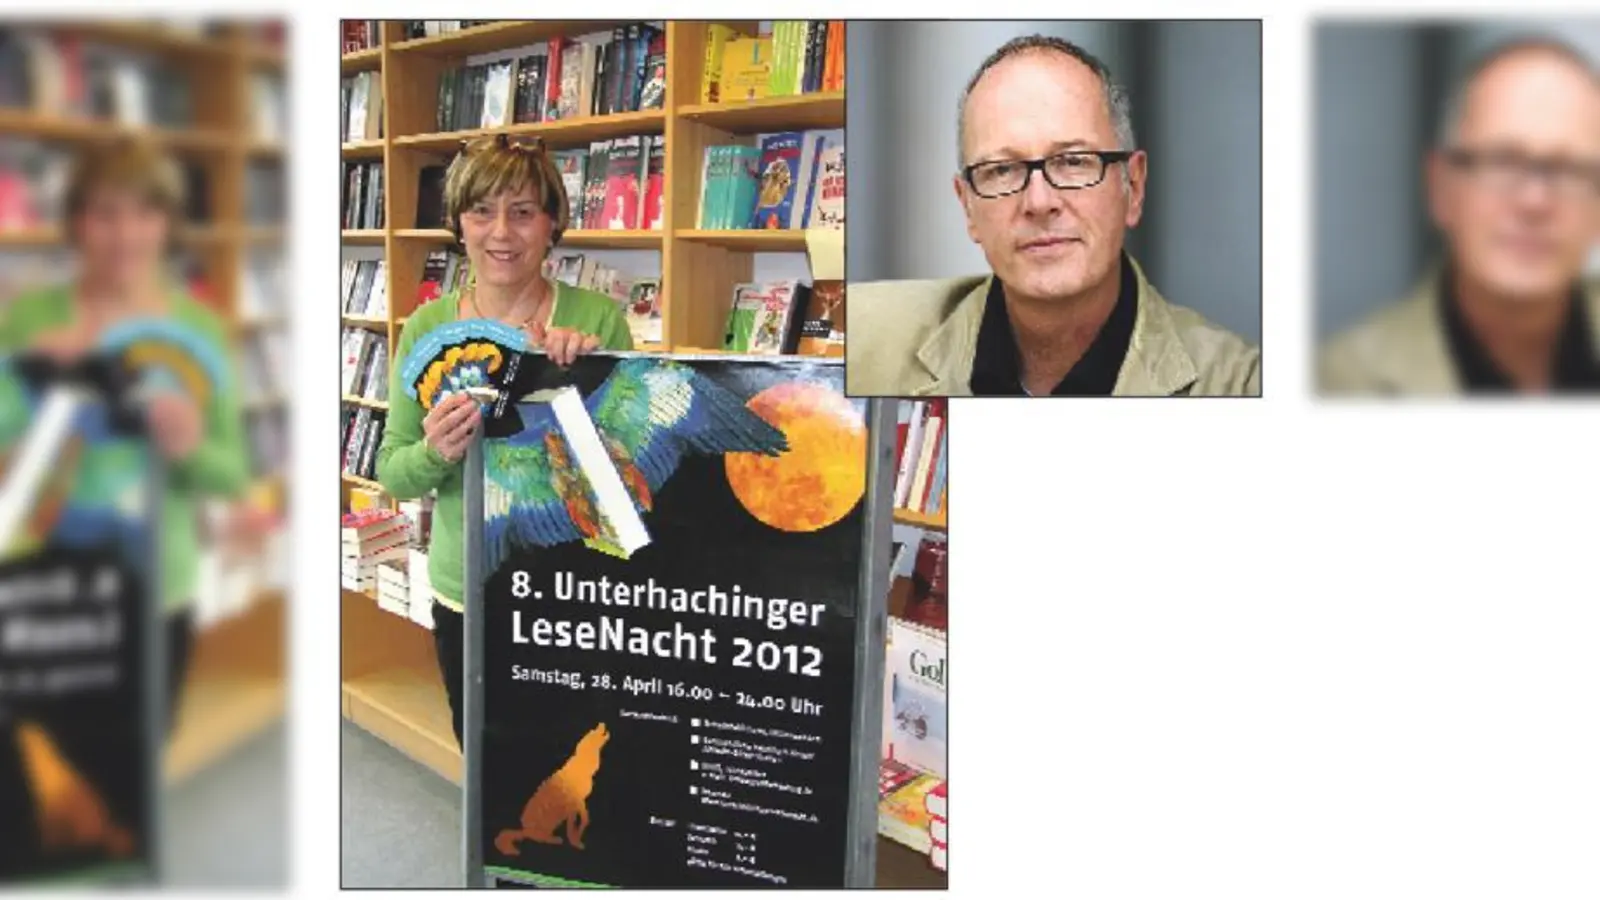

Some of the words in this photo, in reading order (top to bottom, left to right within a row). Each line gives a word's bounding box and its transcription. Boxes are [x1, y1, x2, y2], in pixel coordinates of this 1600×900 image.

[511, 570, 543, 599] 8.
[554, 571, 826, 630] Unterhachinger
[512, 610, 718, 664] LeseNacht
[732, 637, 823, 677] 2012
[511, 665, 586, 690] Samstag,
[591, 674, 617, 690] 28.
[622, 675, 663, 696] April
[666, 683, 713, 701] 16.00
[736, 692, 786, 711] 24.00
[790, 696, 824, 716] Uhr
